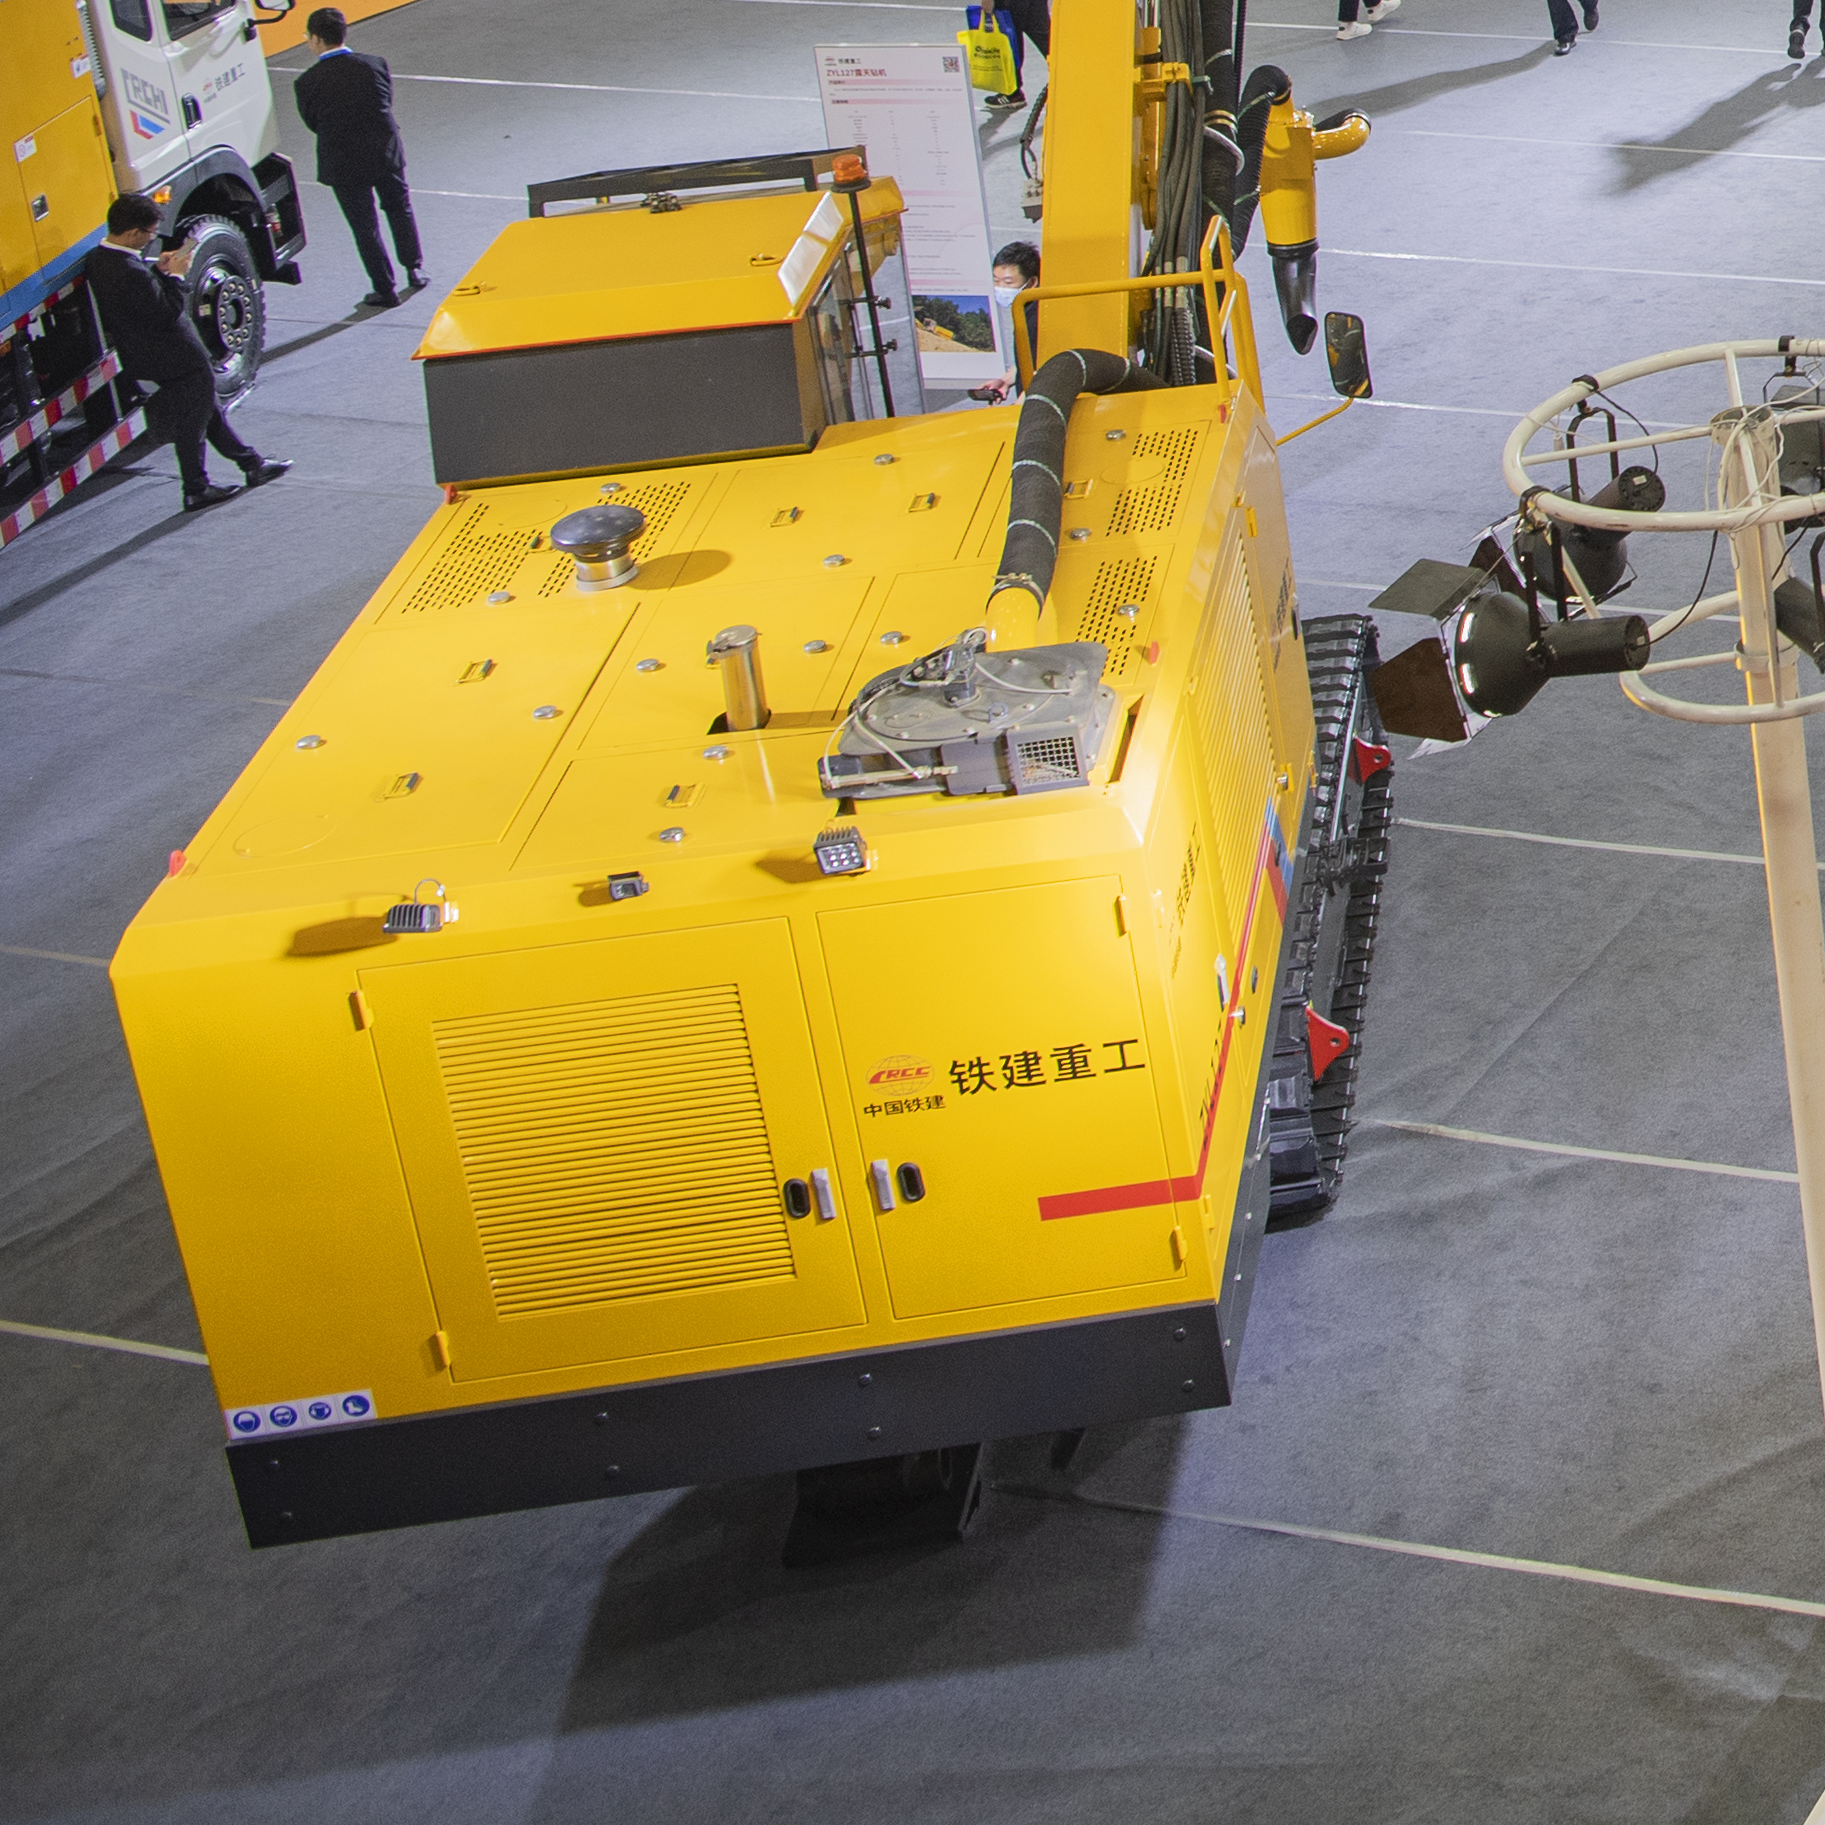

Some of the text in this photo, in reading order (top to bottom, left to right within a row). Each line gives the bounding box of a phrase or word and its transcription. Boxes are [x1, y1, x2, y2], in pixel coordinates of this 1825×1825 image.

[868, 1065, 931, 1085] CRCC
[948, 1038, 1147, 1096] 铁建重工
[863, 1094, 947, 1119] 中国铁建
